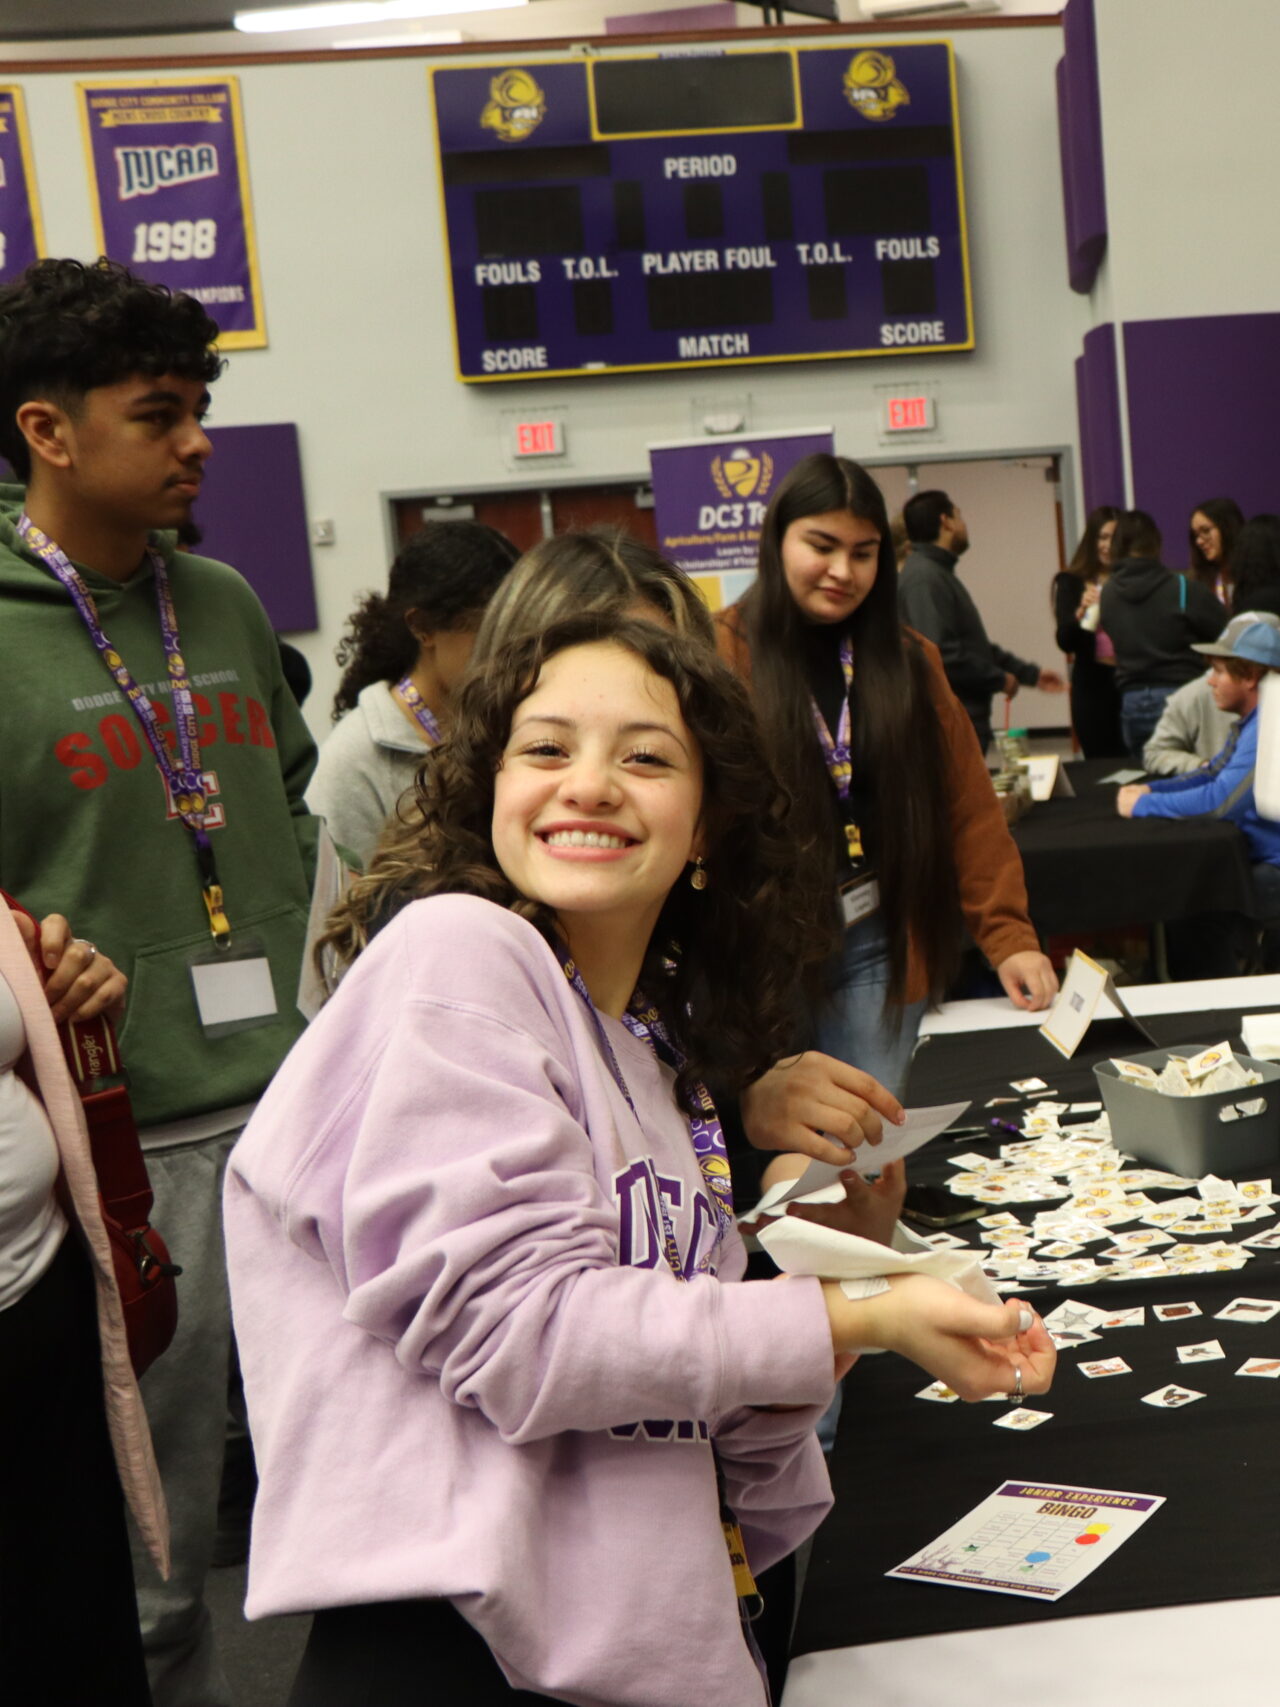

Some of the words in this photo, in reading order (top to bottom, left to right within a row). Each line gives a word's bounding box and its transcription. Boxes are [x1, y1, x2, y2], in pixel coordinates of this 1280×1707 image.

[119, 145, 216, 195] NJCAA
[664, 155, 737, 179] PERIOD
[132, 219, 217, 263] 1998
[797, 242, 853, 266] T.O.L.
[876, 237, 941, 262] FOULS
[476, 261, 541, 286] FOULS
[562, 257, 619, 280] T.O.L.
[642, 250, 720, 275] PLAYER
[725, 246, 777, 271] FOUL
[678, 334, 750, 359] MATCH
[880, 321, 946, 347] SCORE
[482, 346, 548, 372] SCORE
[889, 397, 927, 429] EXIT
[517, 422, 555, 454] EXIT
[700, 505, 744, 530] DC3
[71, 690, 122, 712] DODGE
[193, 669, 240, 687] SCHOOL
[54, 691, 277, 791] SOCCER
[665, 1236, 682, 1273] CITY
[1019, 1486, 1063, 1500] JUNIOR
[1065, 1489, 1139, 1507] EXPERIENCE
[1036, 1502, 1098, 1520] BINGO
